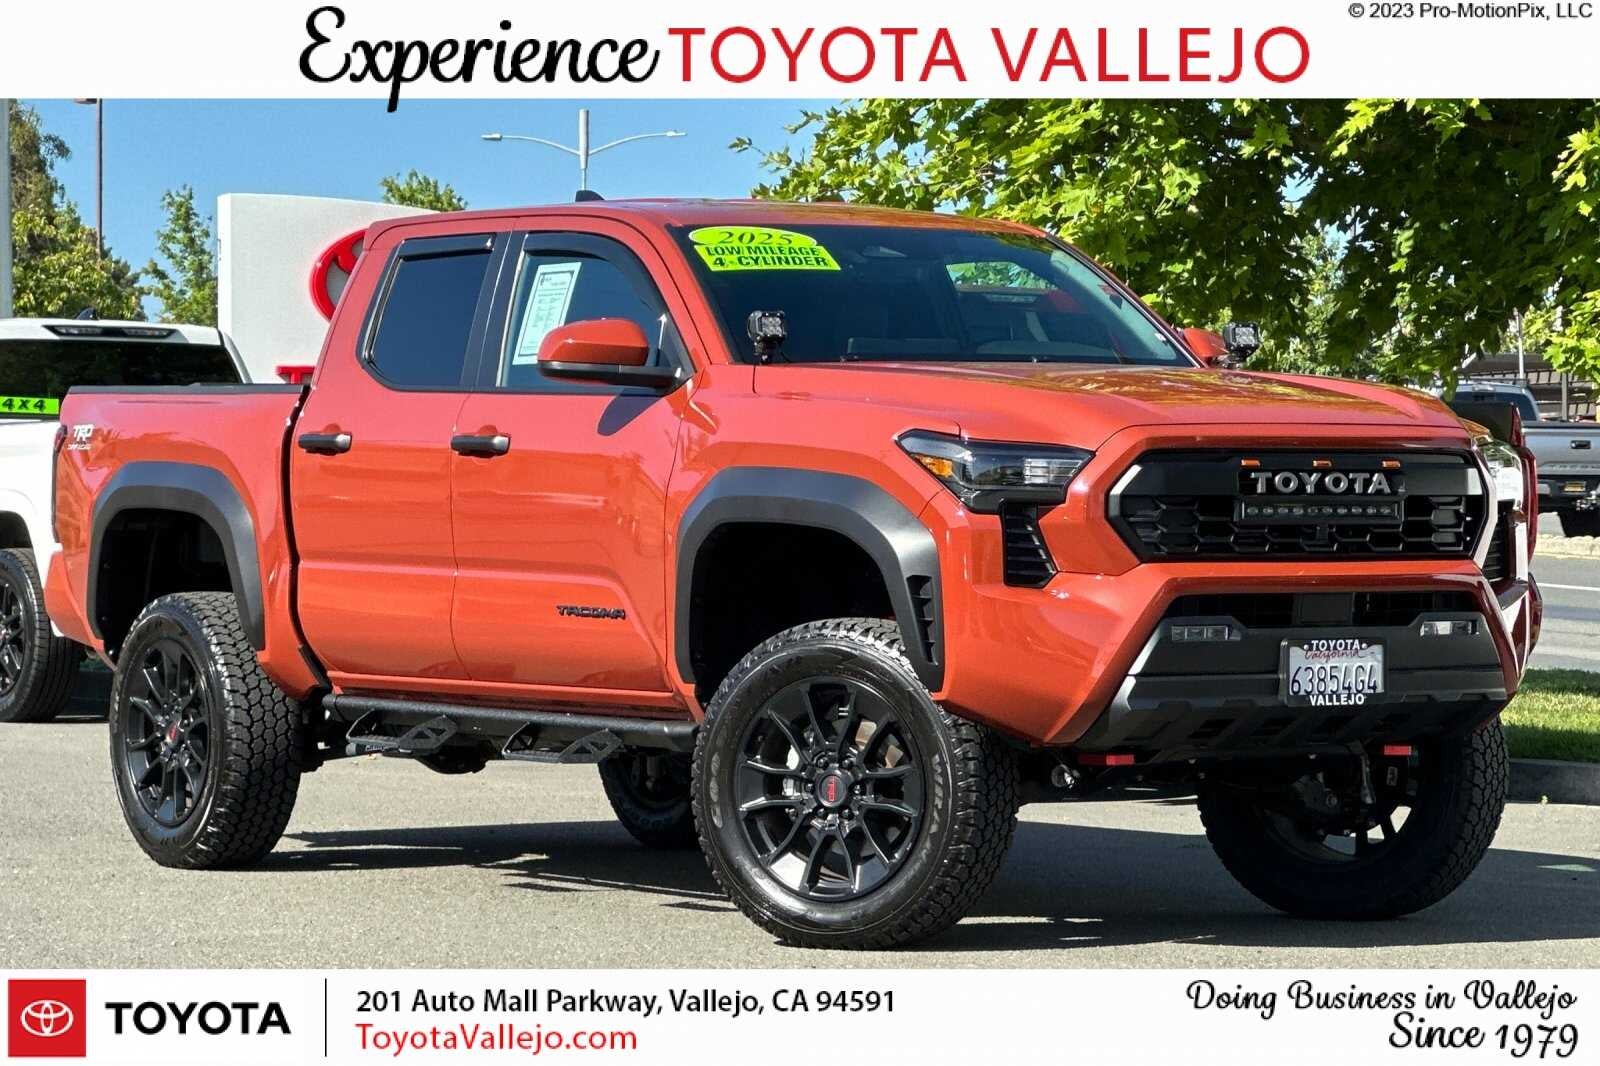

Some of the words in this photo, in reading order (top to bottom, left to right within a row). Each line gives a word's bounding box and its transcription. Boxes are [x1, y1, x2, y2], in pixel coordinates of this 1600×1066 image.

[718, 231, 794, 245] 2025
[705, 246, 742, 256] LOW
[745, 246, 820, 257] MILEAGE
[73, 424, 96, 441] TRD
[1250, 471, 1391, 494] TOYOTA
[556, 605, 626, 620] TACOMA
[1311, 640, 1361, 651] TOYOTA
[1291, 665, 1378, 695] 63854G4
[1309, 694, 1365, 706] VALLEJO
